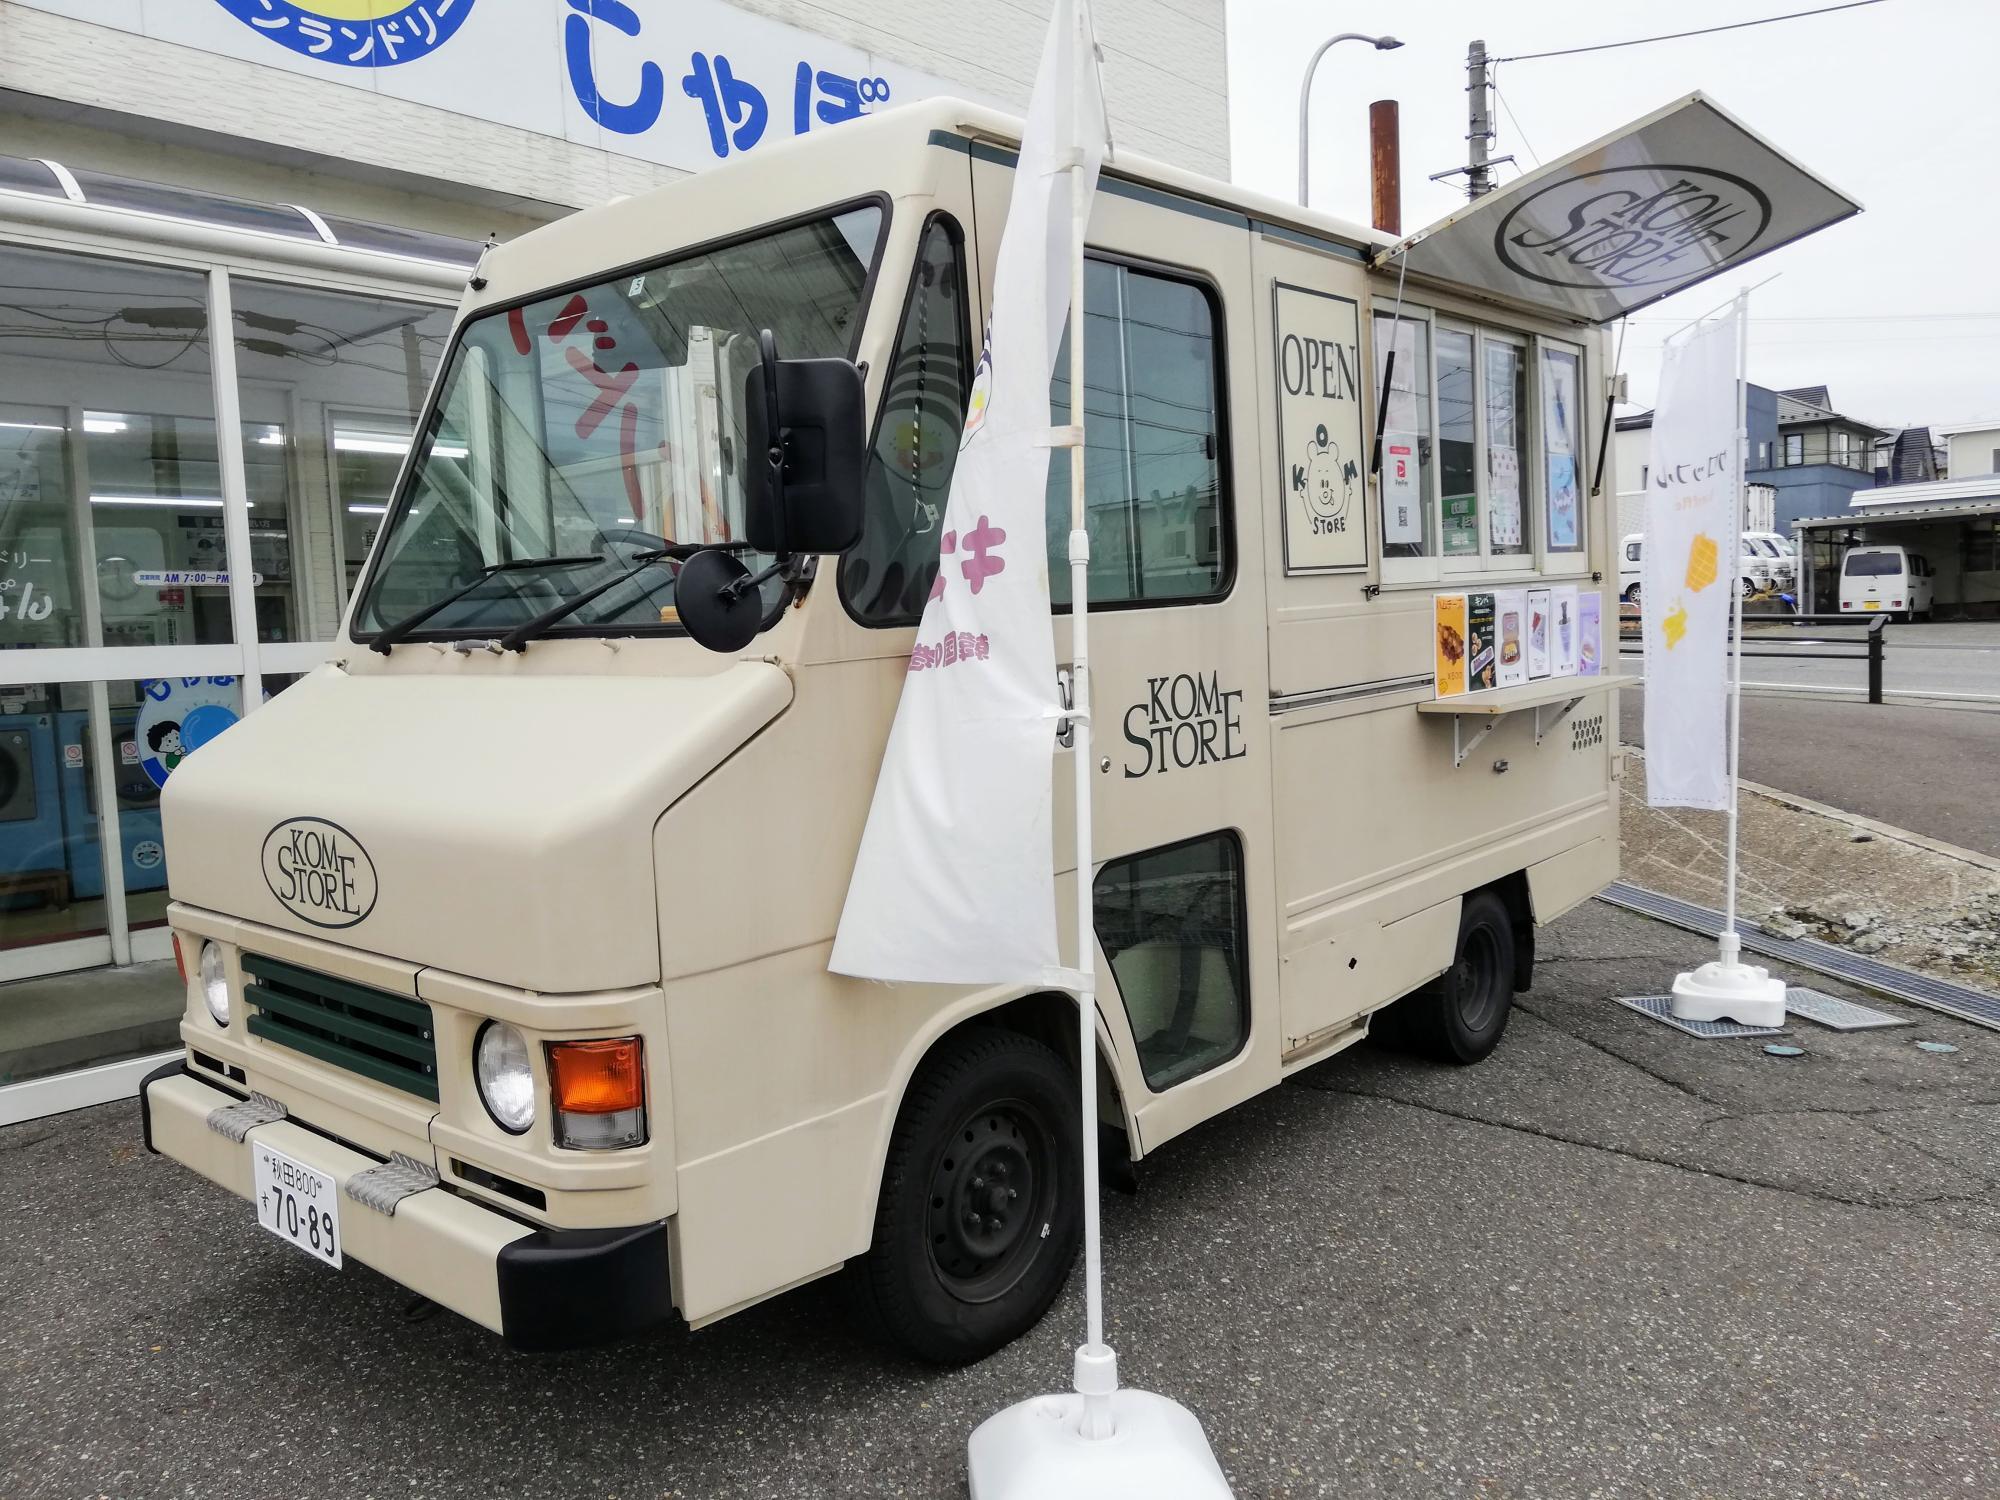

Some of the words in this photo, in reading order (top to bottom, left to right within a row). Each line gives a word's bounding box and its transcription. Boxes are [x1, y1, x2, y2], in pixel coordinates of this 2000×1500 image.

[1282, 333, 1356, 402] OPEN
[1312, 516, 1346, 535] STORE
[164, 574, 179, 583] AM
[272, 1185, 335, 1258] 70-89
